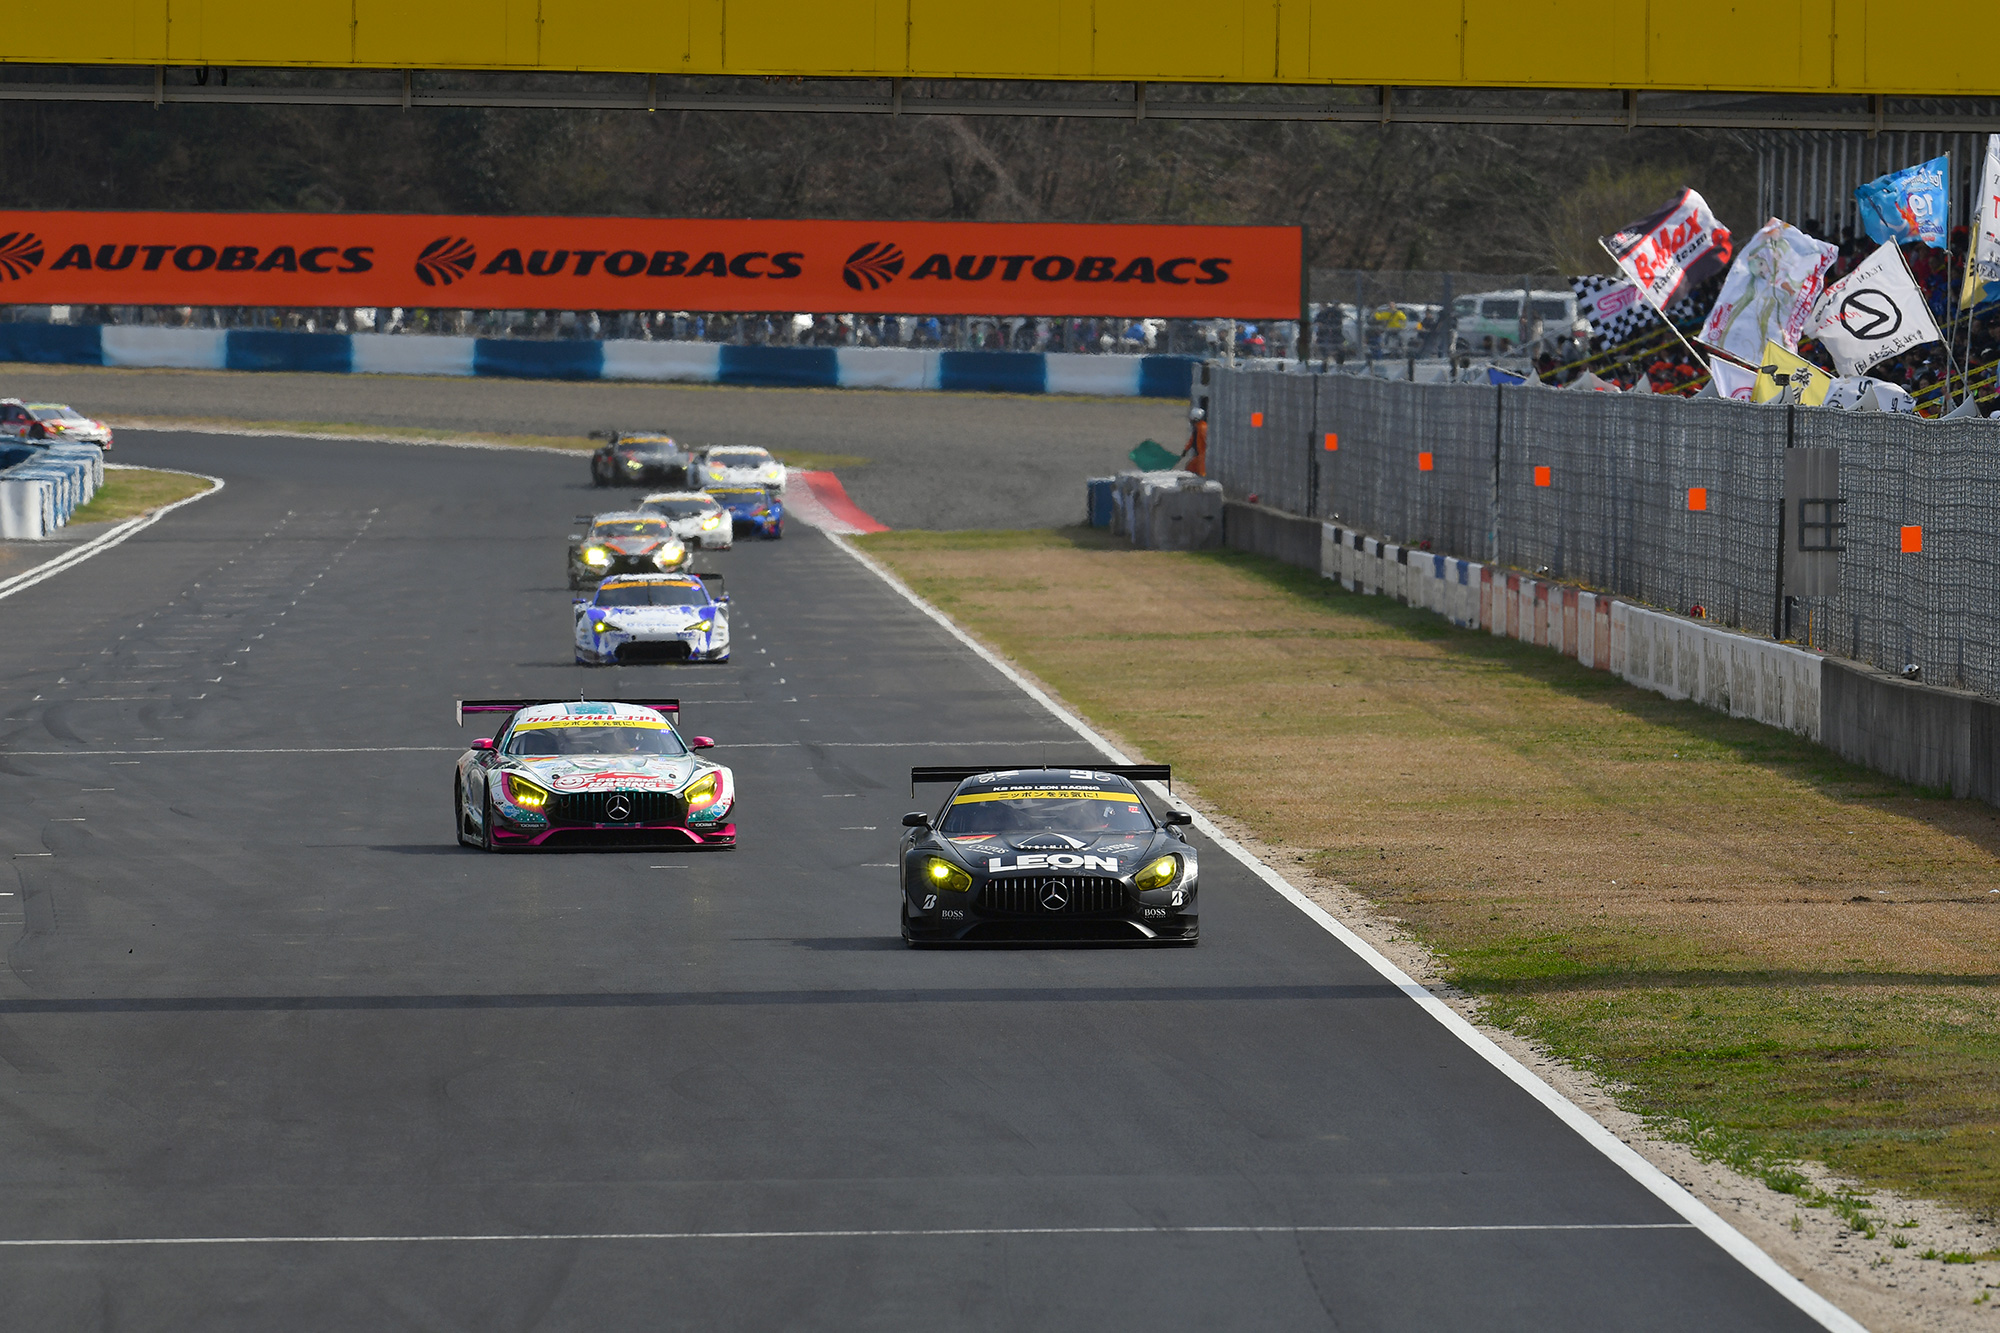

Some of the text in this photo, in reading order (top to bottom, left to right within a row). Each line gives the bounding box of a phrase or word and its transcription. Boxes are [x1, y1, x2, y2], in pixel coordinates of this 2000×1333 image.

[49, 244, 375, 274] AUTOBACS
[479, 247, 805, 280] AUTOBACS
[1634, 207, 1702, 290] B-Max
[914, 253, 1233, 286] AUTOBACS
[1652, 262, 1681, 295] Racing
[989, 853, 1119, 873] LEON
[942, 910, 964, 918] BOSS
[1144, 908, 1166, 916] BOSS
